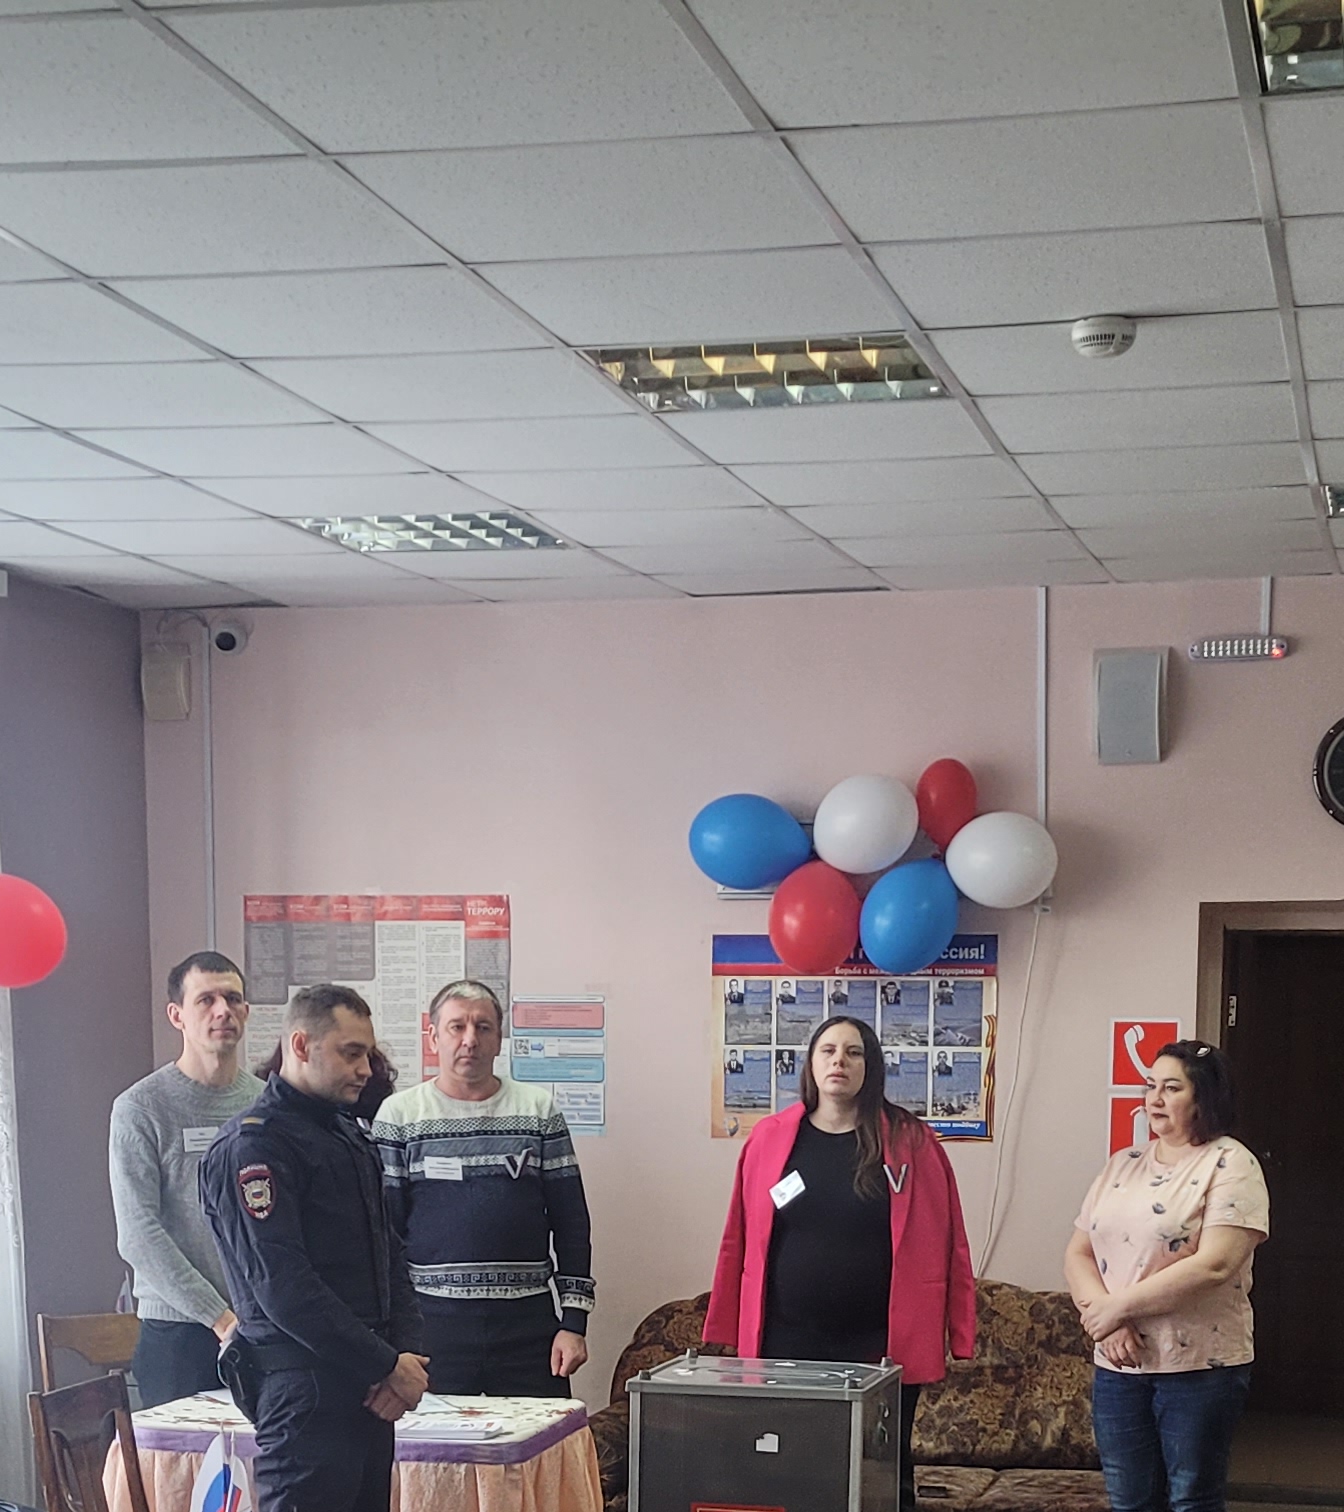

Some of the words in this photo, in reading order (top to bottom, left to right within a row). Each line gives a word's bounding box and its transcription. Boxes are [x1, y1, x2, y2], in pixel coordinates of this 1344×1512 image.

[467, 907, 505, 916] ТЕРРОРУ
[940, 943, 985, 960] ссия!
[934, 967, 985, 976] терроризмом
